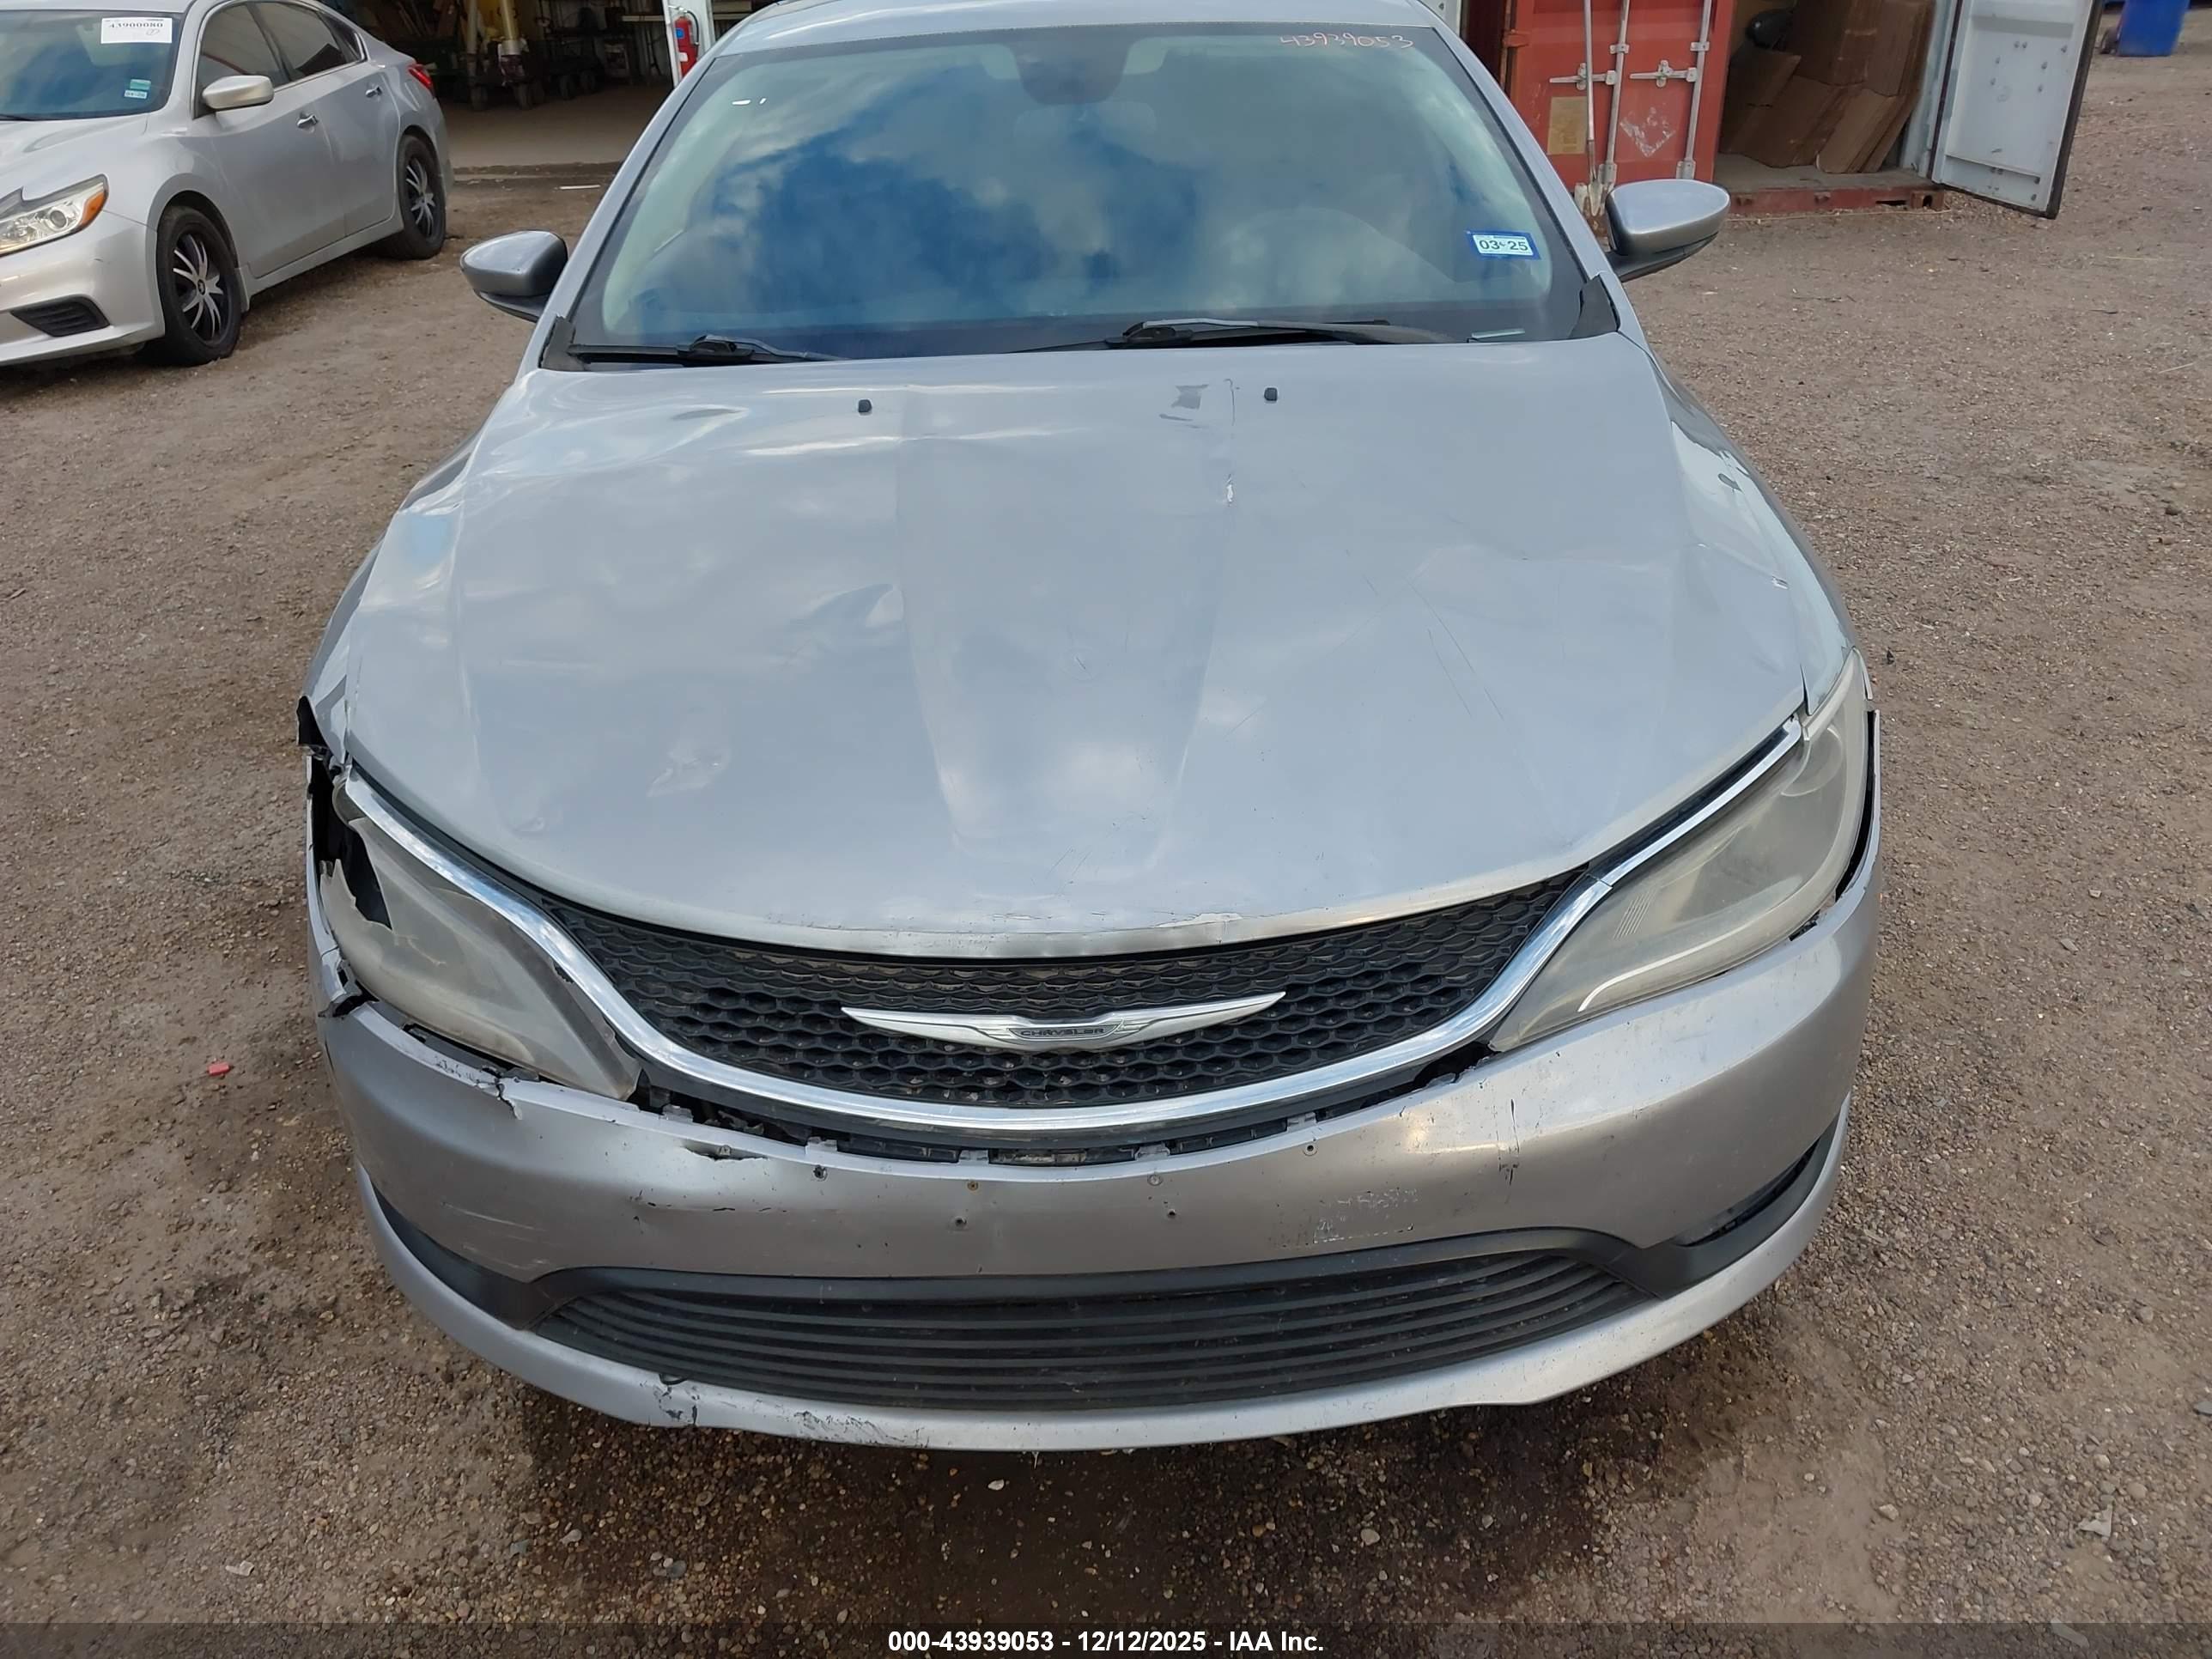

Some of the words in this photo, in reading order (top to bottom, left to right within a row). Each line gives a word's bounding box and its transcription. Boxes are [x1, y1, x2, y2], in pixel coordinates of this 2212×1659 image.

[1279, 32, 1413, 49] 43939053
[1479, 240, 1500, 250] 03
[1507, 240, 1528, 251] 25
[1019, 1027, 1105, 1037] CHRYSLER
